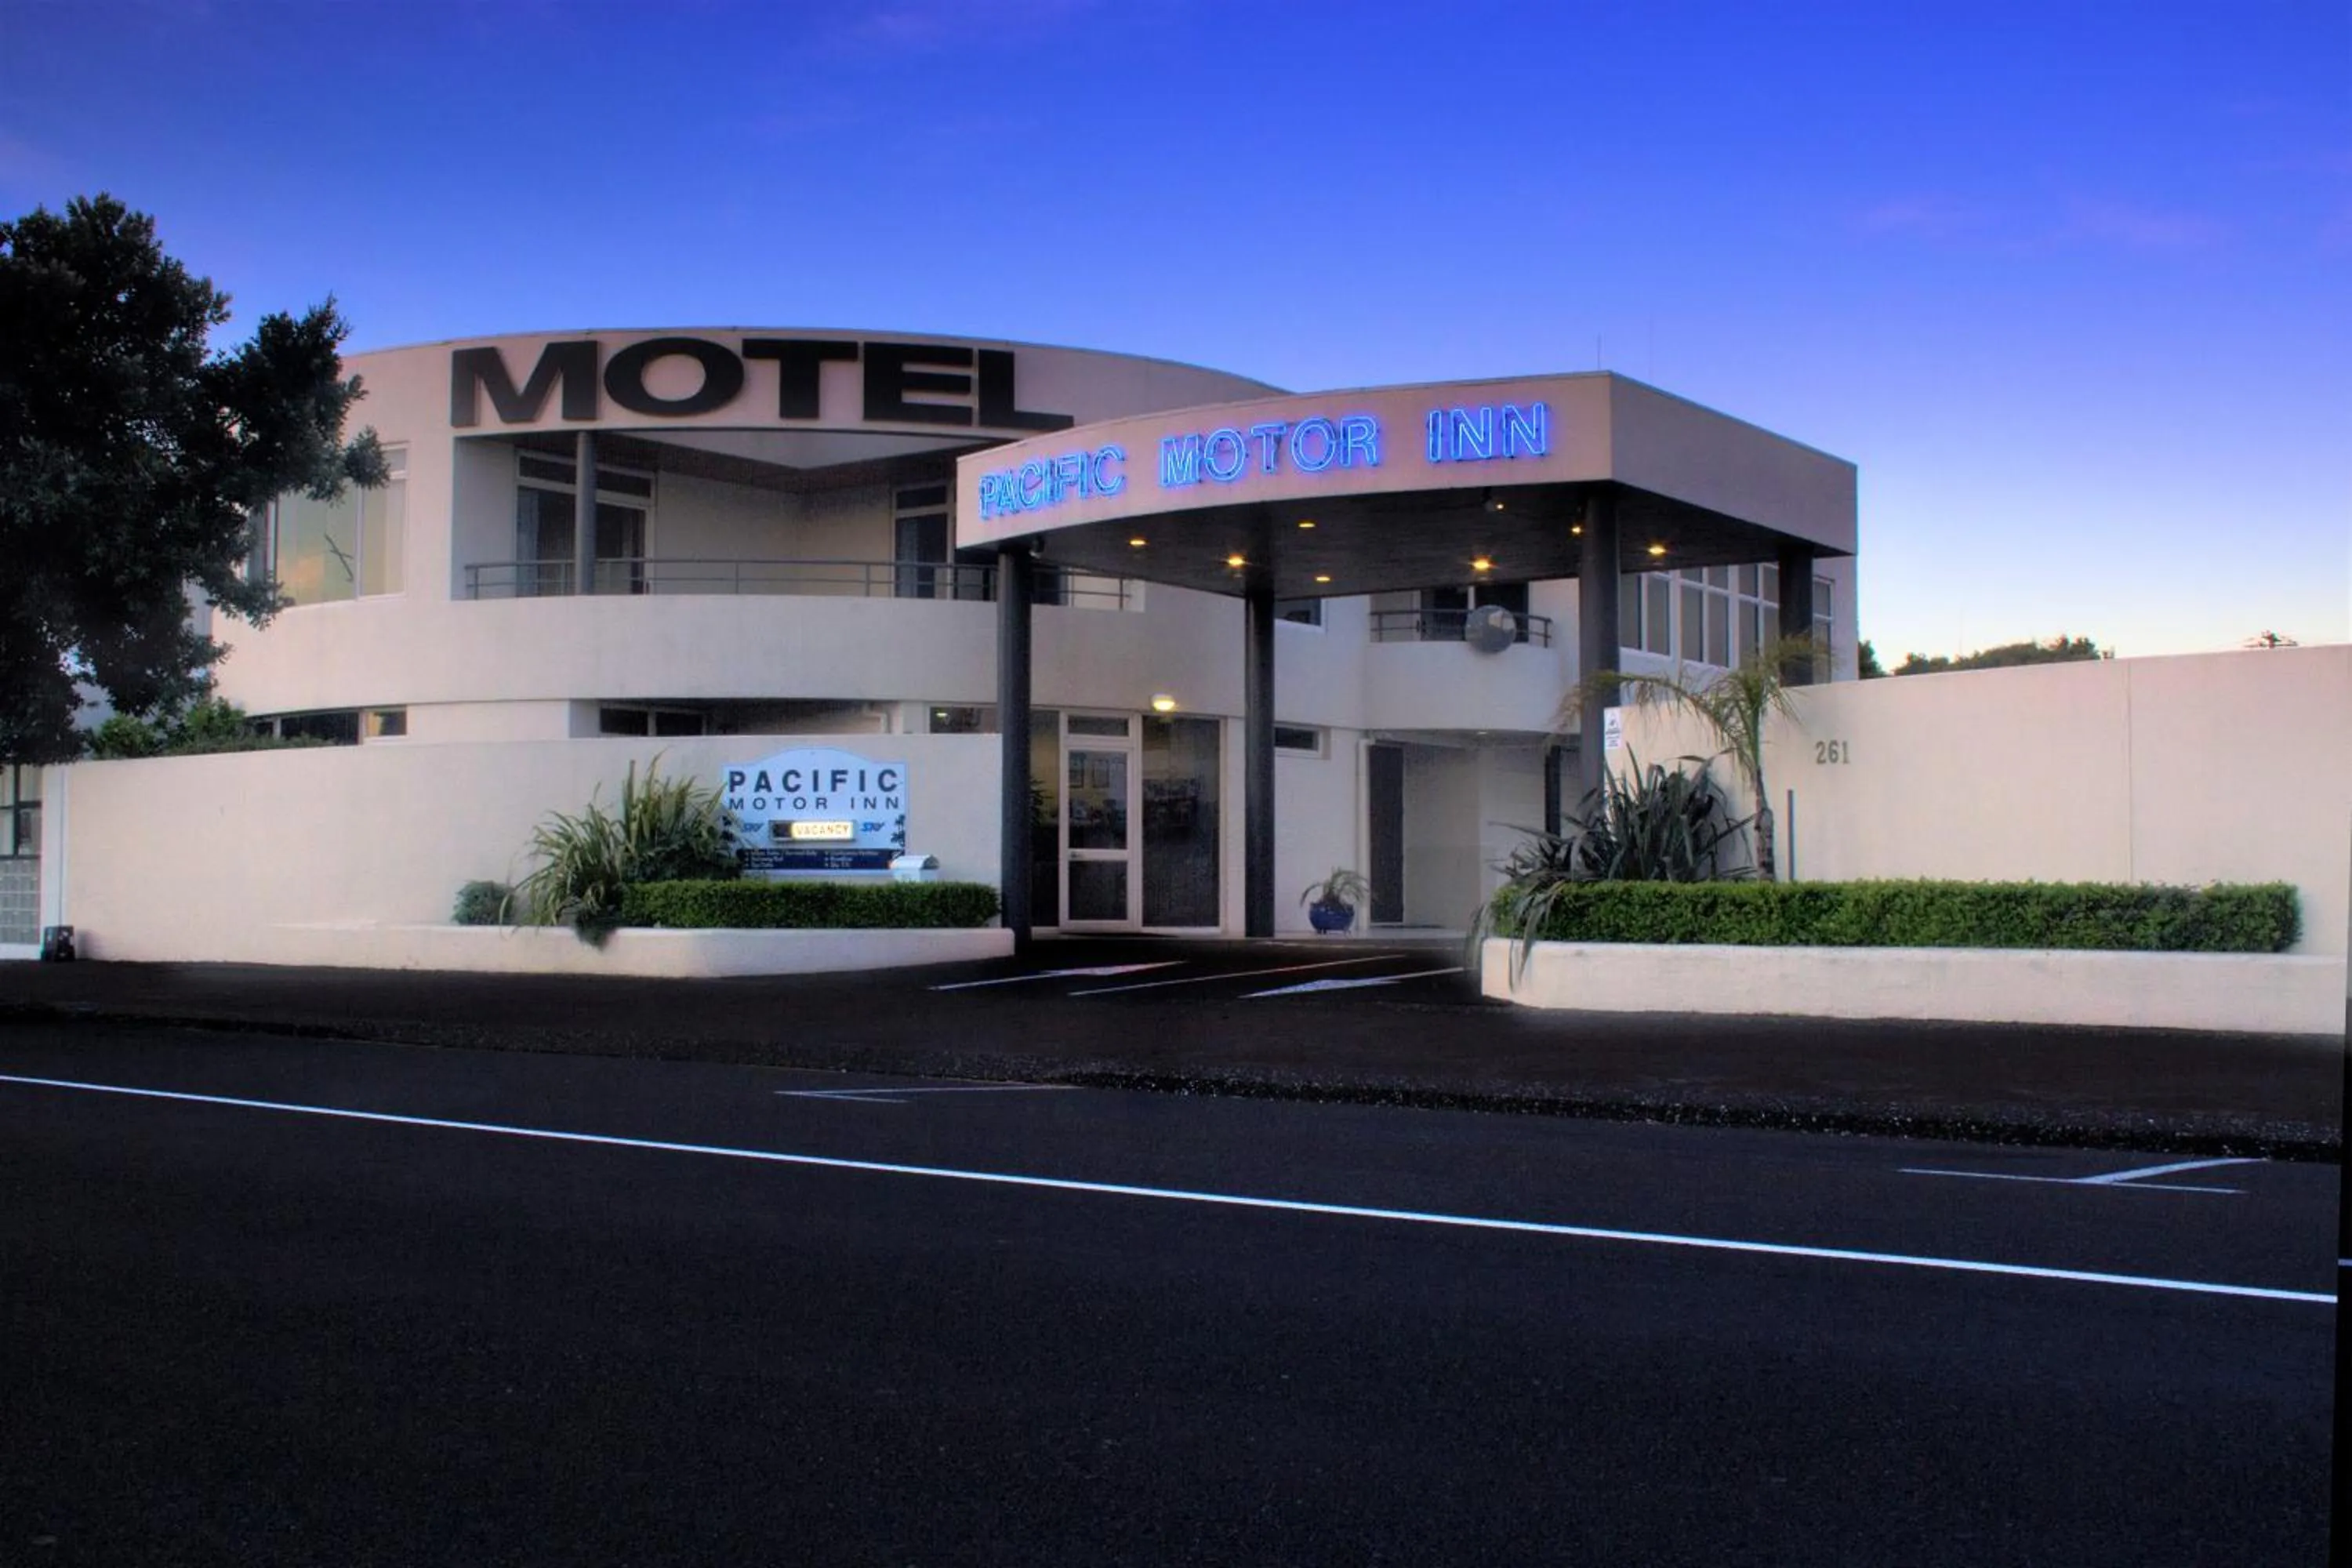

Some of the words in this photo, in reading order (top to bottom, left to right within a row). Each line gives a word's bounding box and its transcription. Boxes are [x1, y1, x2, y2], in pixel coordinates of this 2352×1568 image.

[451, 336, 1074, 427] MOTEL
[979, 445, 1125, 521] PACIFIC
[1160, 416, 1380, 487] MOTOR
[1428, 401, 1546, 462] INN
[1815, 740, 1849, 764] 261
[728, 769, 898, 793] PACIFIC
[728, 797, 828, 810] MOTOR
[851, 797, 899, 810] INN
